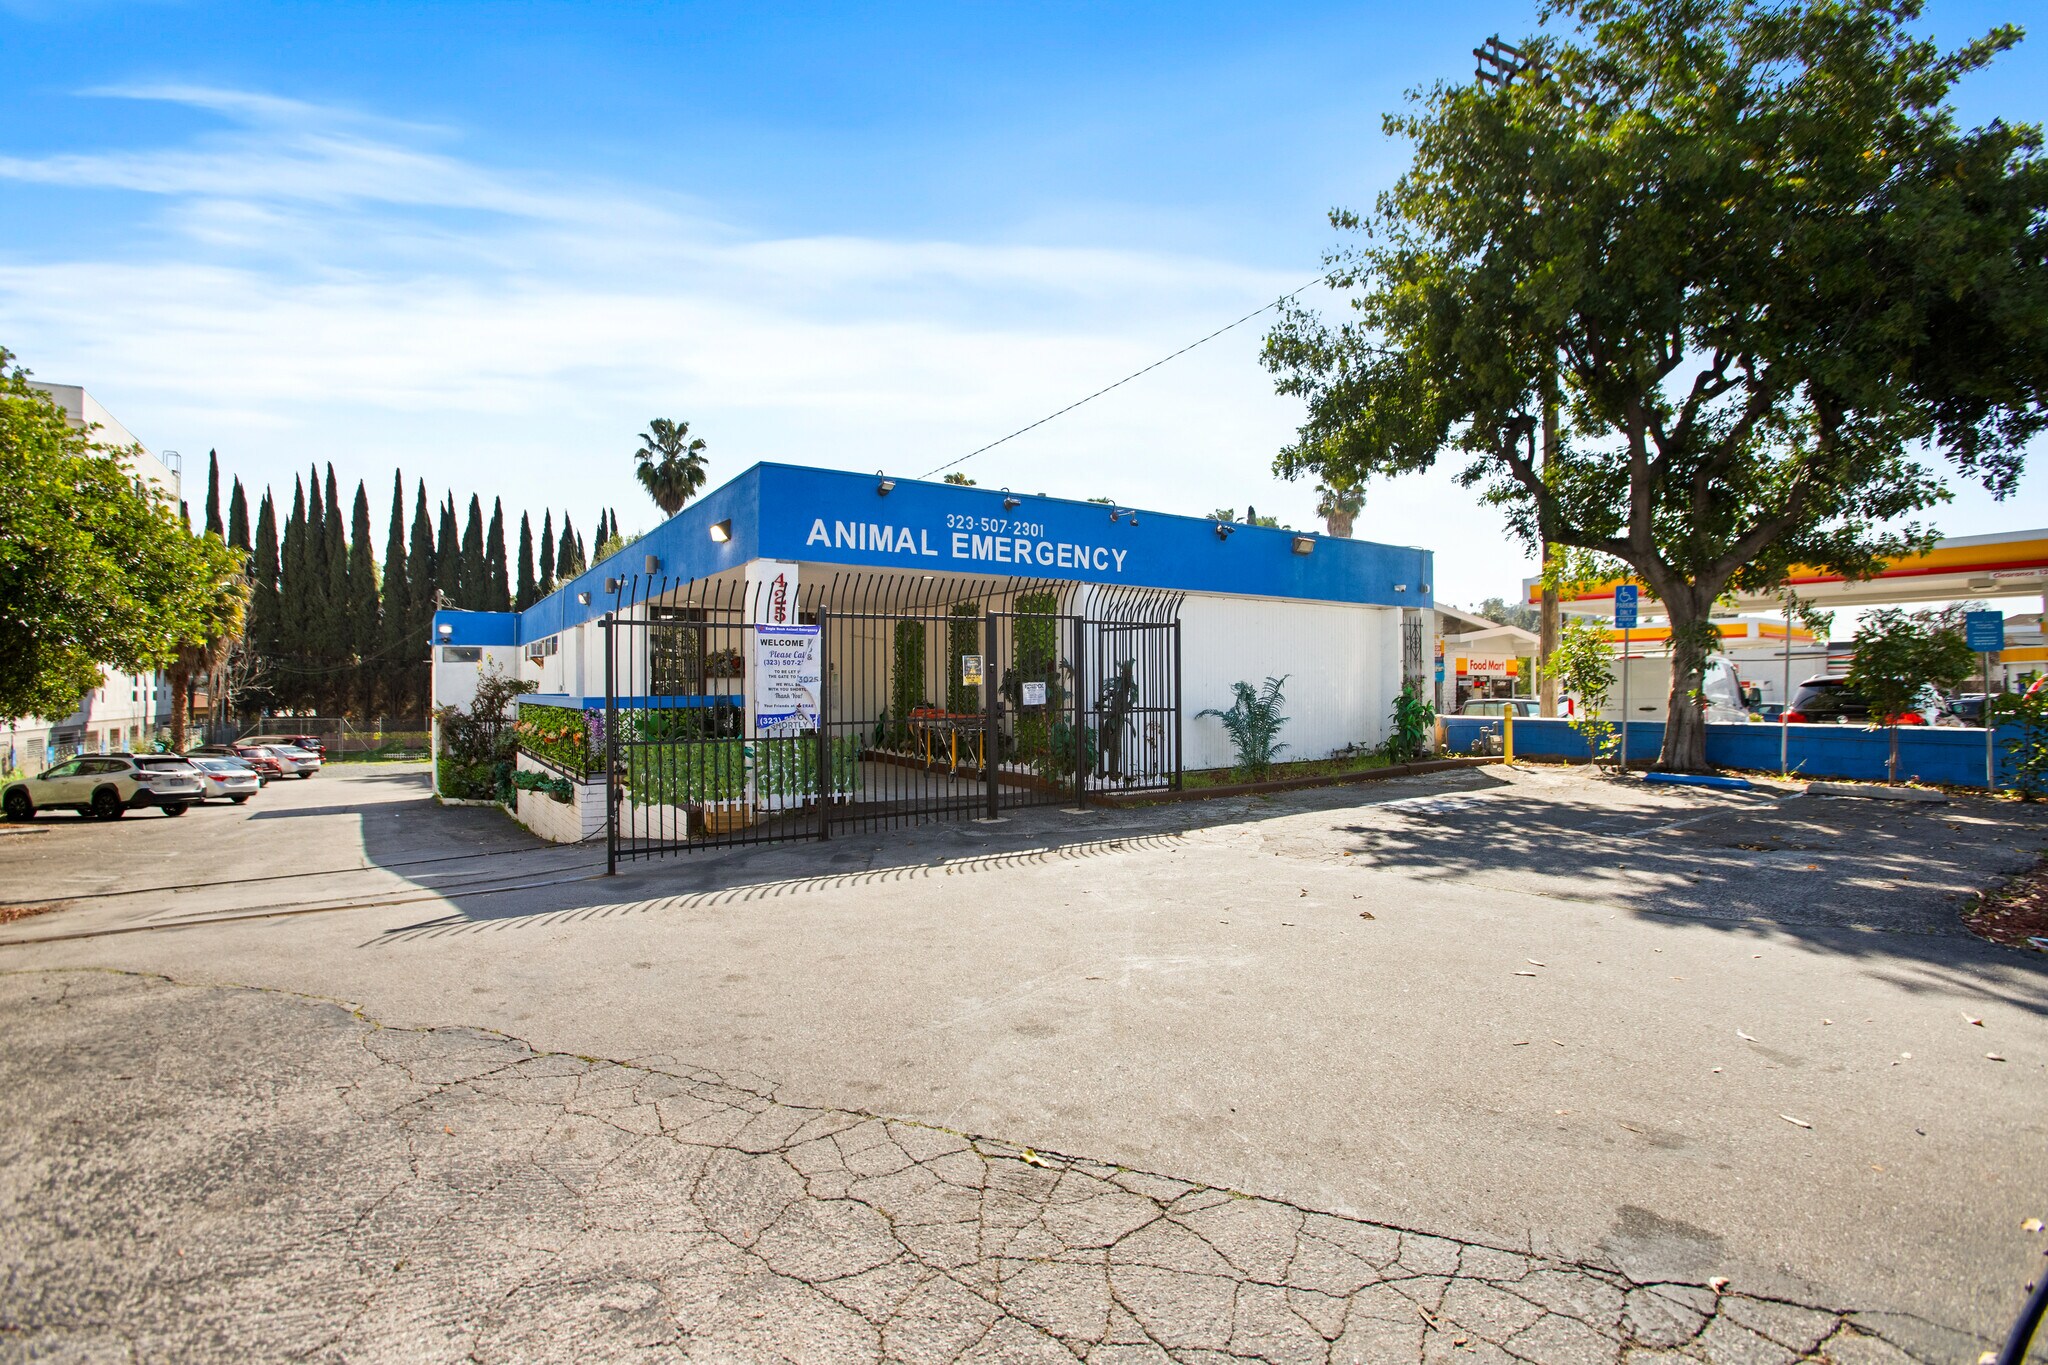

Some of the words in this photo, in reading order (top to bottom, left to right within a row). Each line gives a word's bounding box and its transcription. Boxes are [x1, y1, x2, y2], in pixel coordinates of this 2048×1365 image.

[946, 514, 1044, 537] 323-507-2301
[806, 518, 938, 556] ANIMAL
[952, 532, 1127, 572] EMERGENCY
[760, 639, 804, 647] WELCOME
[770, 650, 792, 659] Please
[763, 659, 781, 667] (323)
[1469, 659, 1487, 671] Food
[1488, 660, 1505, 671] Mart
